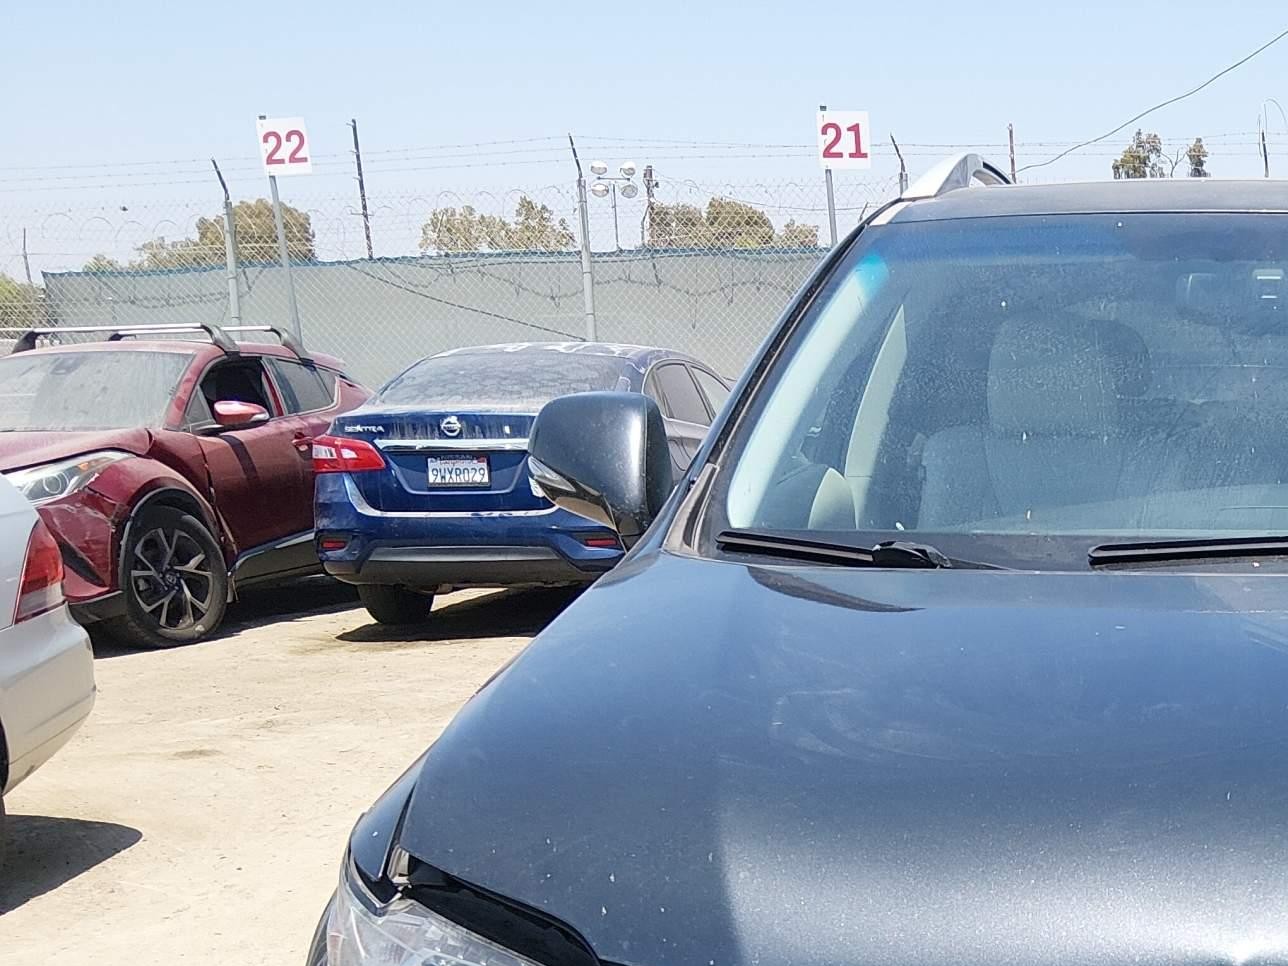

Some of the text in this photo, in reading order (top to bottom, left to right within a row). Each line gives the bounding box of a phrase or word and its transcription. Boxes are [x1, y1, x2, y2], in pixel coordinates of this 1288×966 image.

[262, 129, 308, 165] 22
[821, 122, 868, 159] 21
[344, 424, 385, 433] SENTRA
[431, 467, 486, 483] 9WXR029
